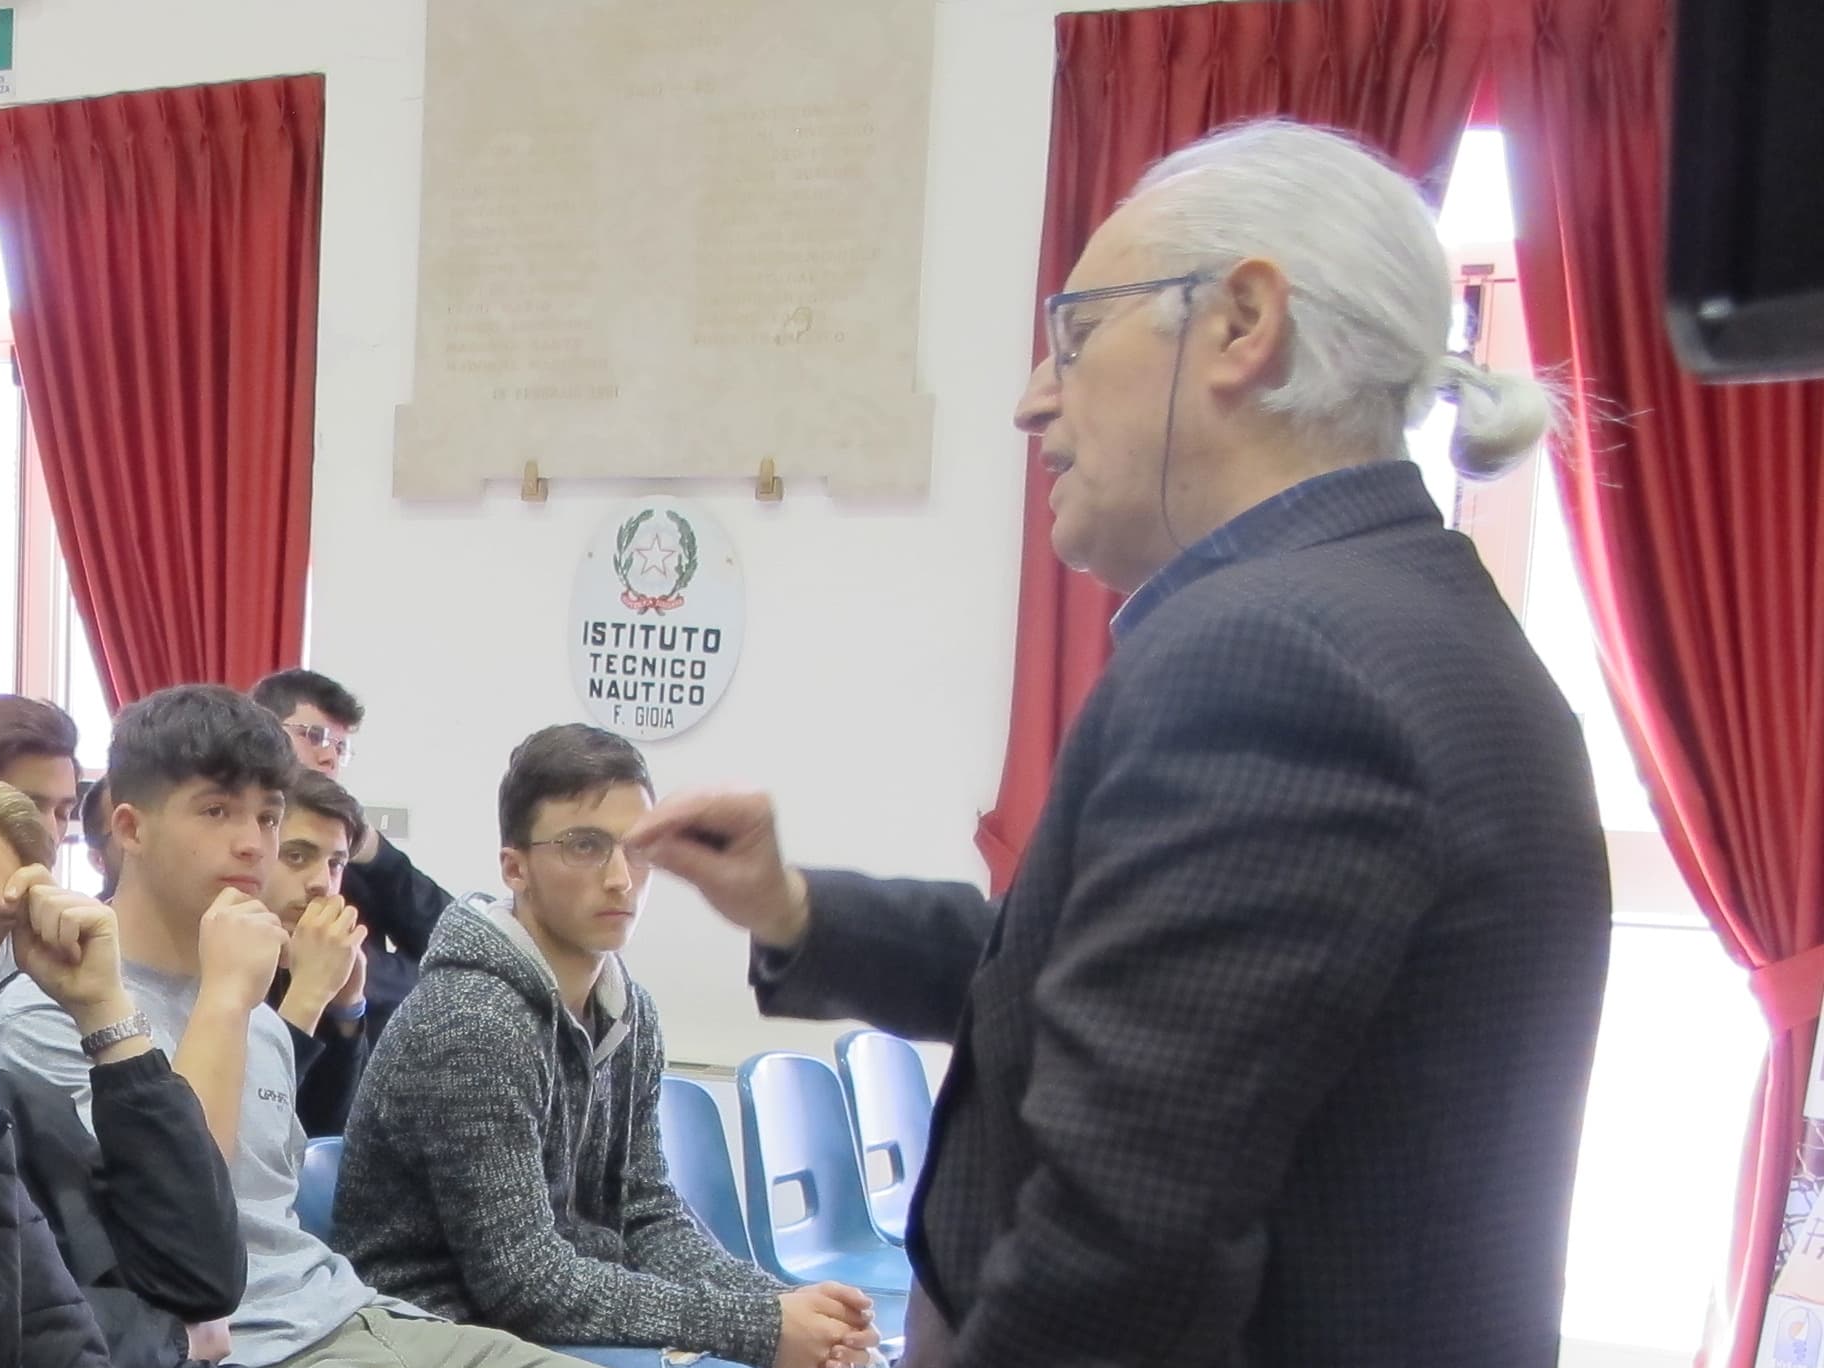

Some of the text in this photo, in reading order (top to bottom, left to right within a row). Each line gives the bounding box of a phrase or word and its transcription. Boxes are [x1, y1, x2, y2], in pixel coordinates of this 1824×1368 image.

[582, 620, 722, 654] ISTITUTO
[589, 652, 707, 681] TECNICO
[589, 677, 705, 707] NAUTICO
[613, 704, 675, 730] F. GIOIA
